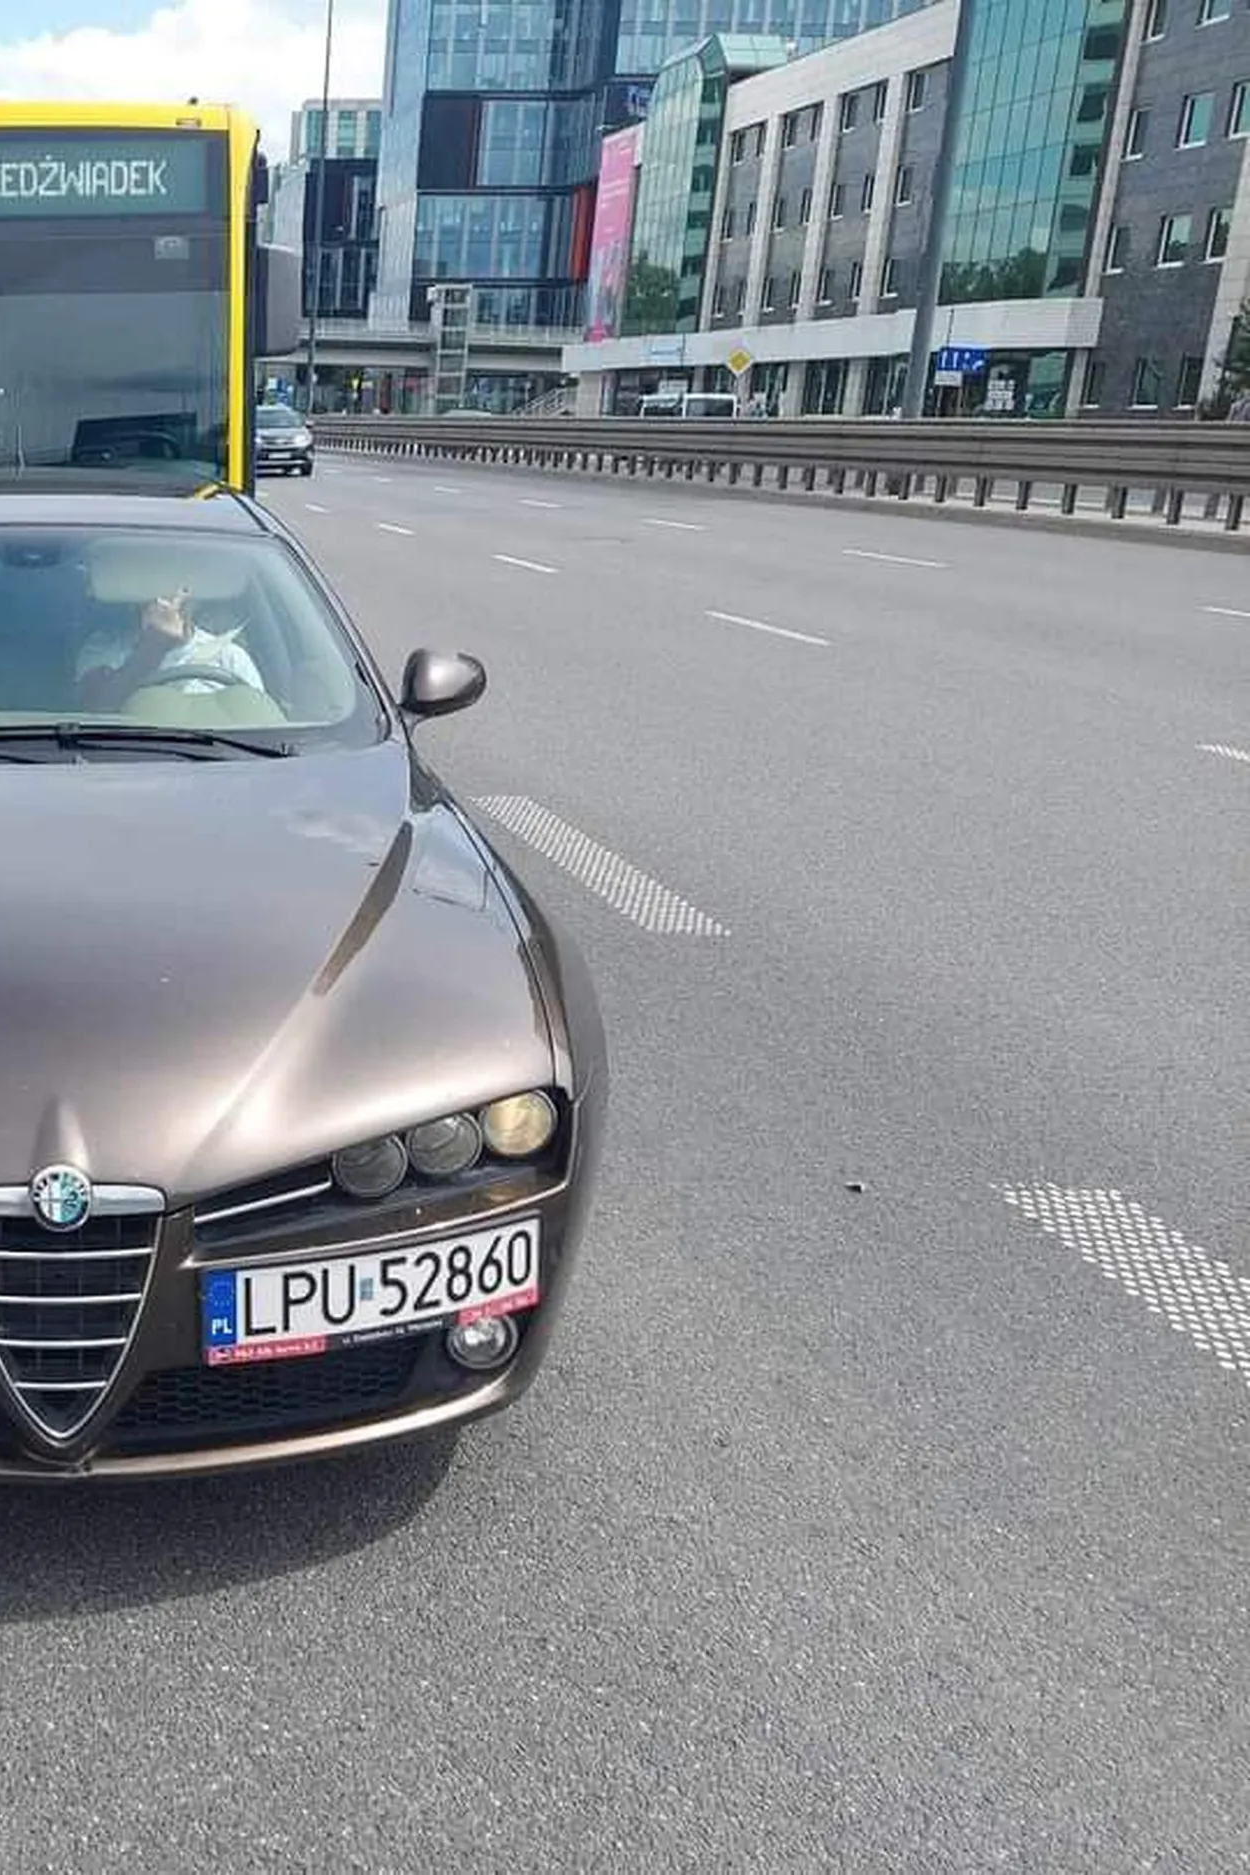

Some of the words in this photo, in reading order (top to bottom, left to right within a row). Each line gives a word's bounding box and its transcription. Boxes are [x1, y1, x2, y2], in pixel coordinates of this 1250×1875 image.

[244, 1264, 356, 1336] LPU
[379, 1230, 532, 1316] 52860
[211, 1319, 233, 1335] PL
